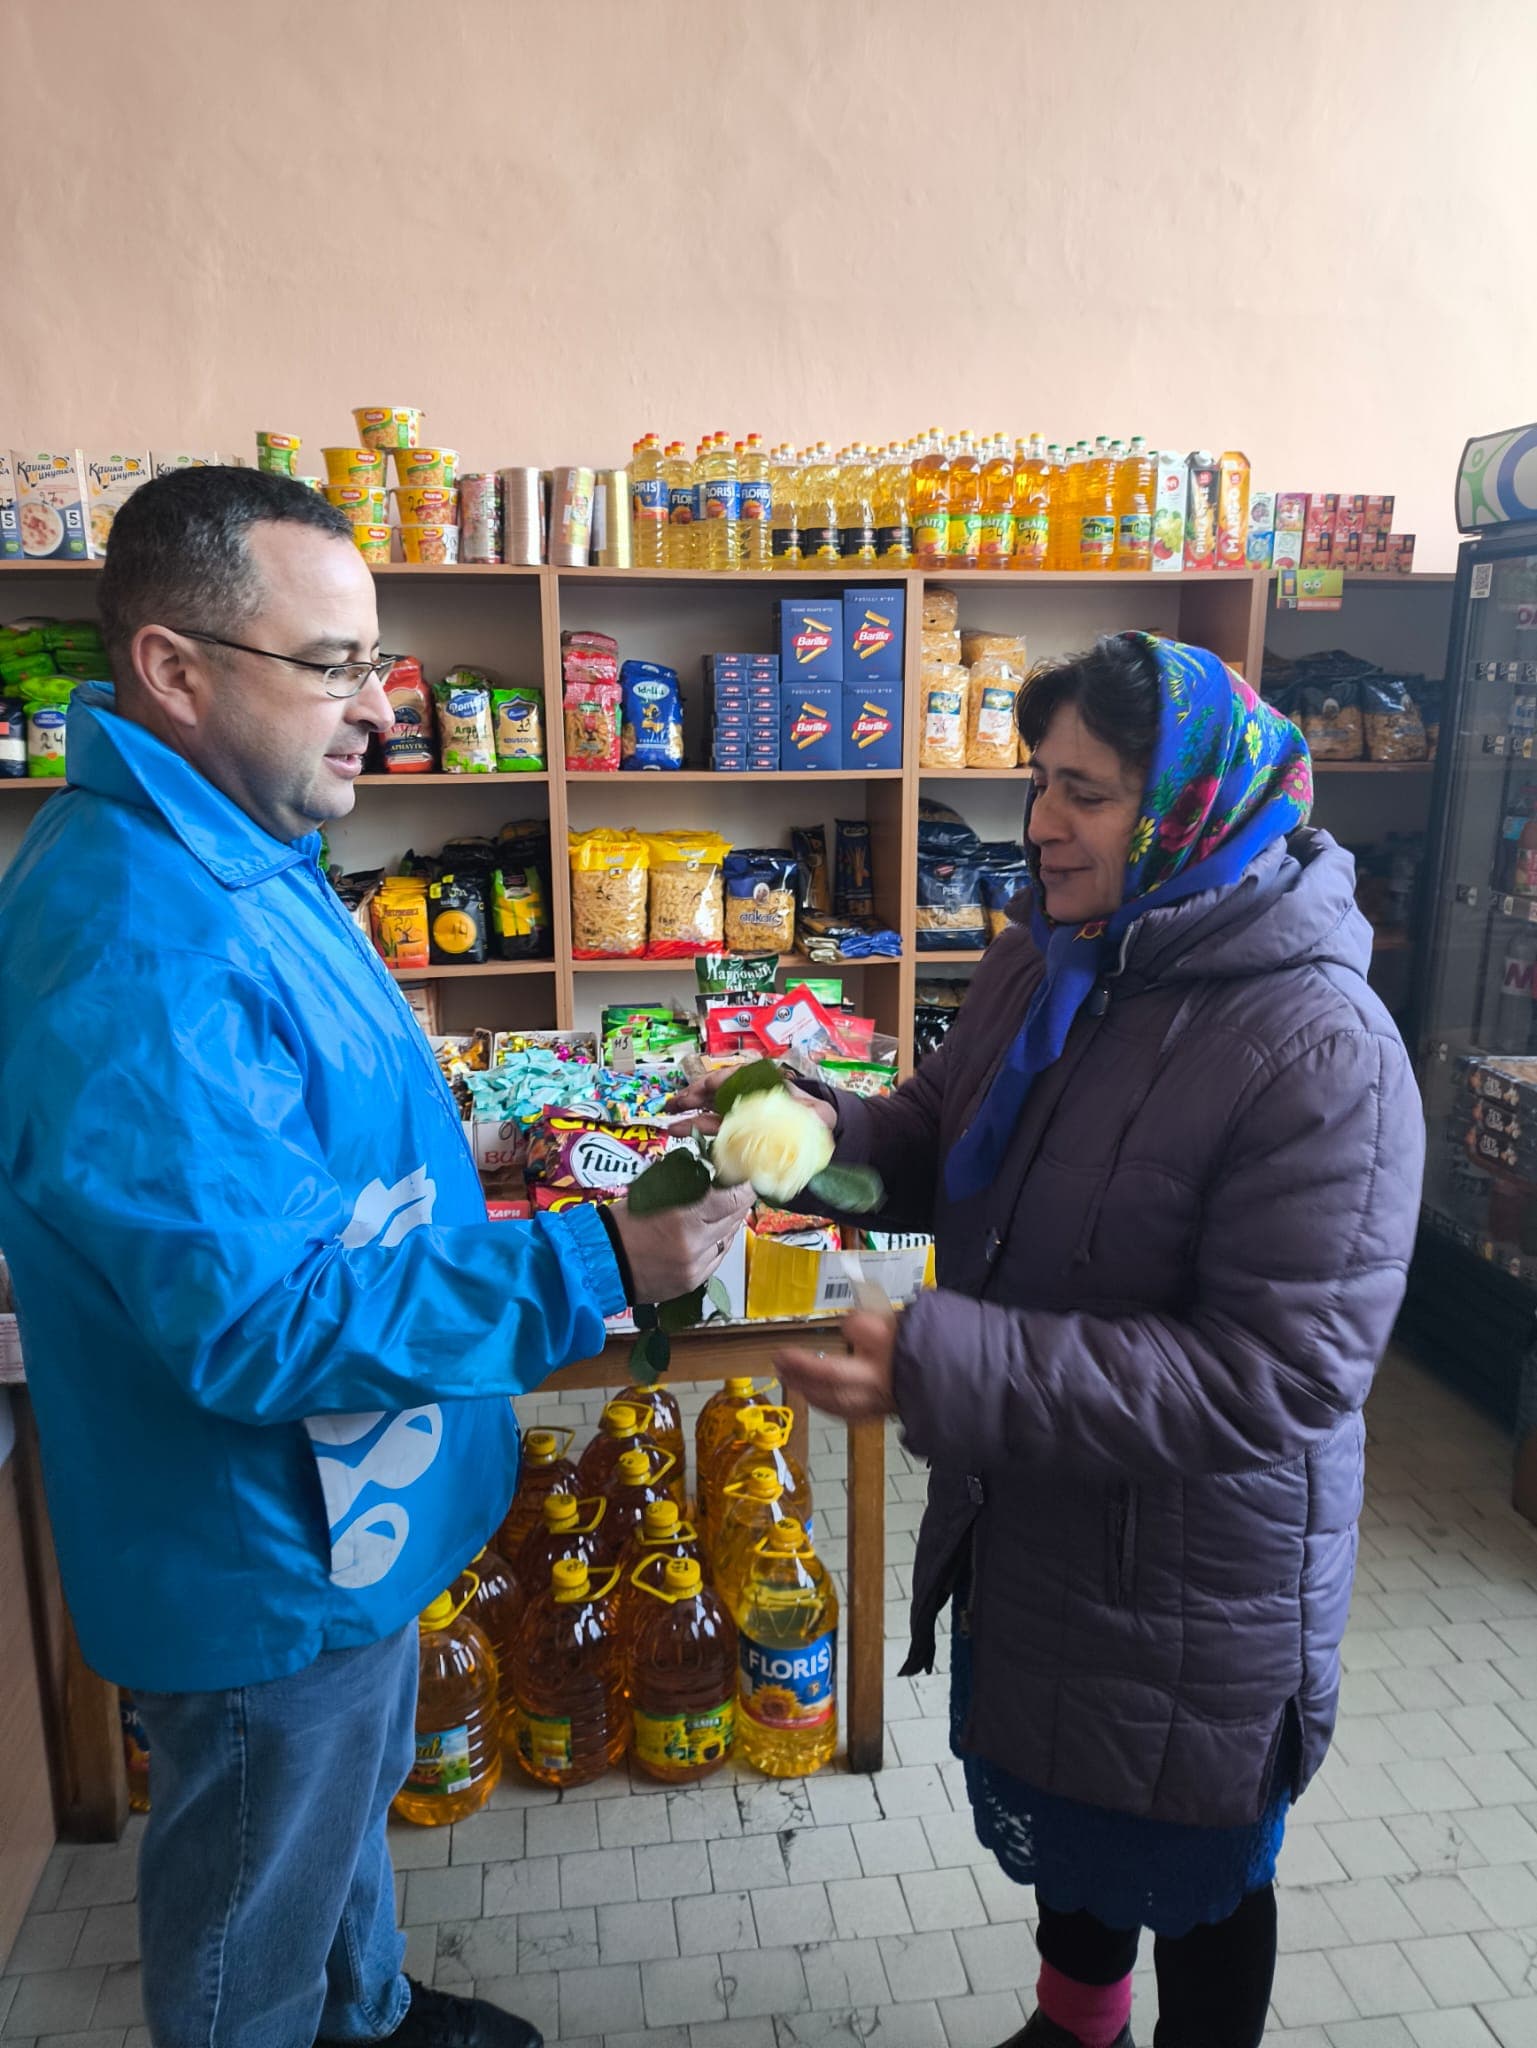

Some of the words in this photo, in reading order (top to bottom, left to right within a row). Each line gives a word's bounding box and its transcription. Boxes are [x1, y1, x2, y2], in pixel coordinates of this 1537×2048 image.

[632, 482, 657, 496] ORIS
[4, 513, 14, 527] 5
[69, 512, 79, 526] 5
[797, 636, 828, 646] Barilla
[859, 631, 890, 641] Barilla
[797, 722, 828, 732] Barilla
[857, 721, 889, 731] Barilla
[582, 1150, 641, 1176] flint
[748, 1646, 830, 1681] FLORIS
